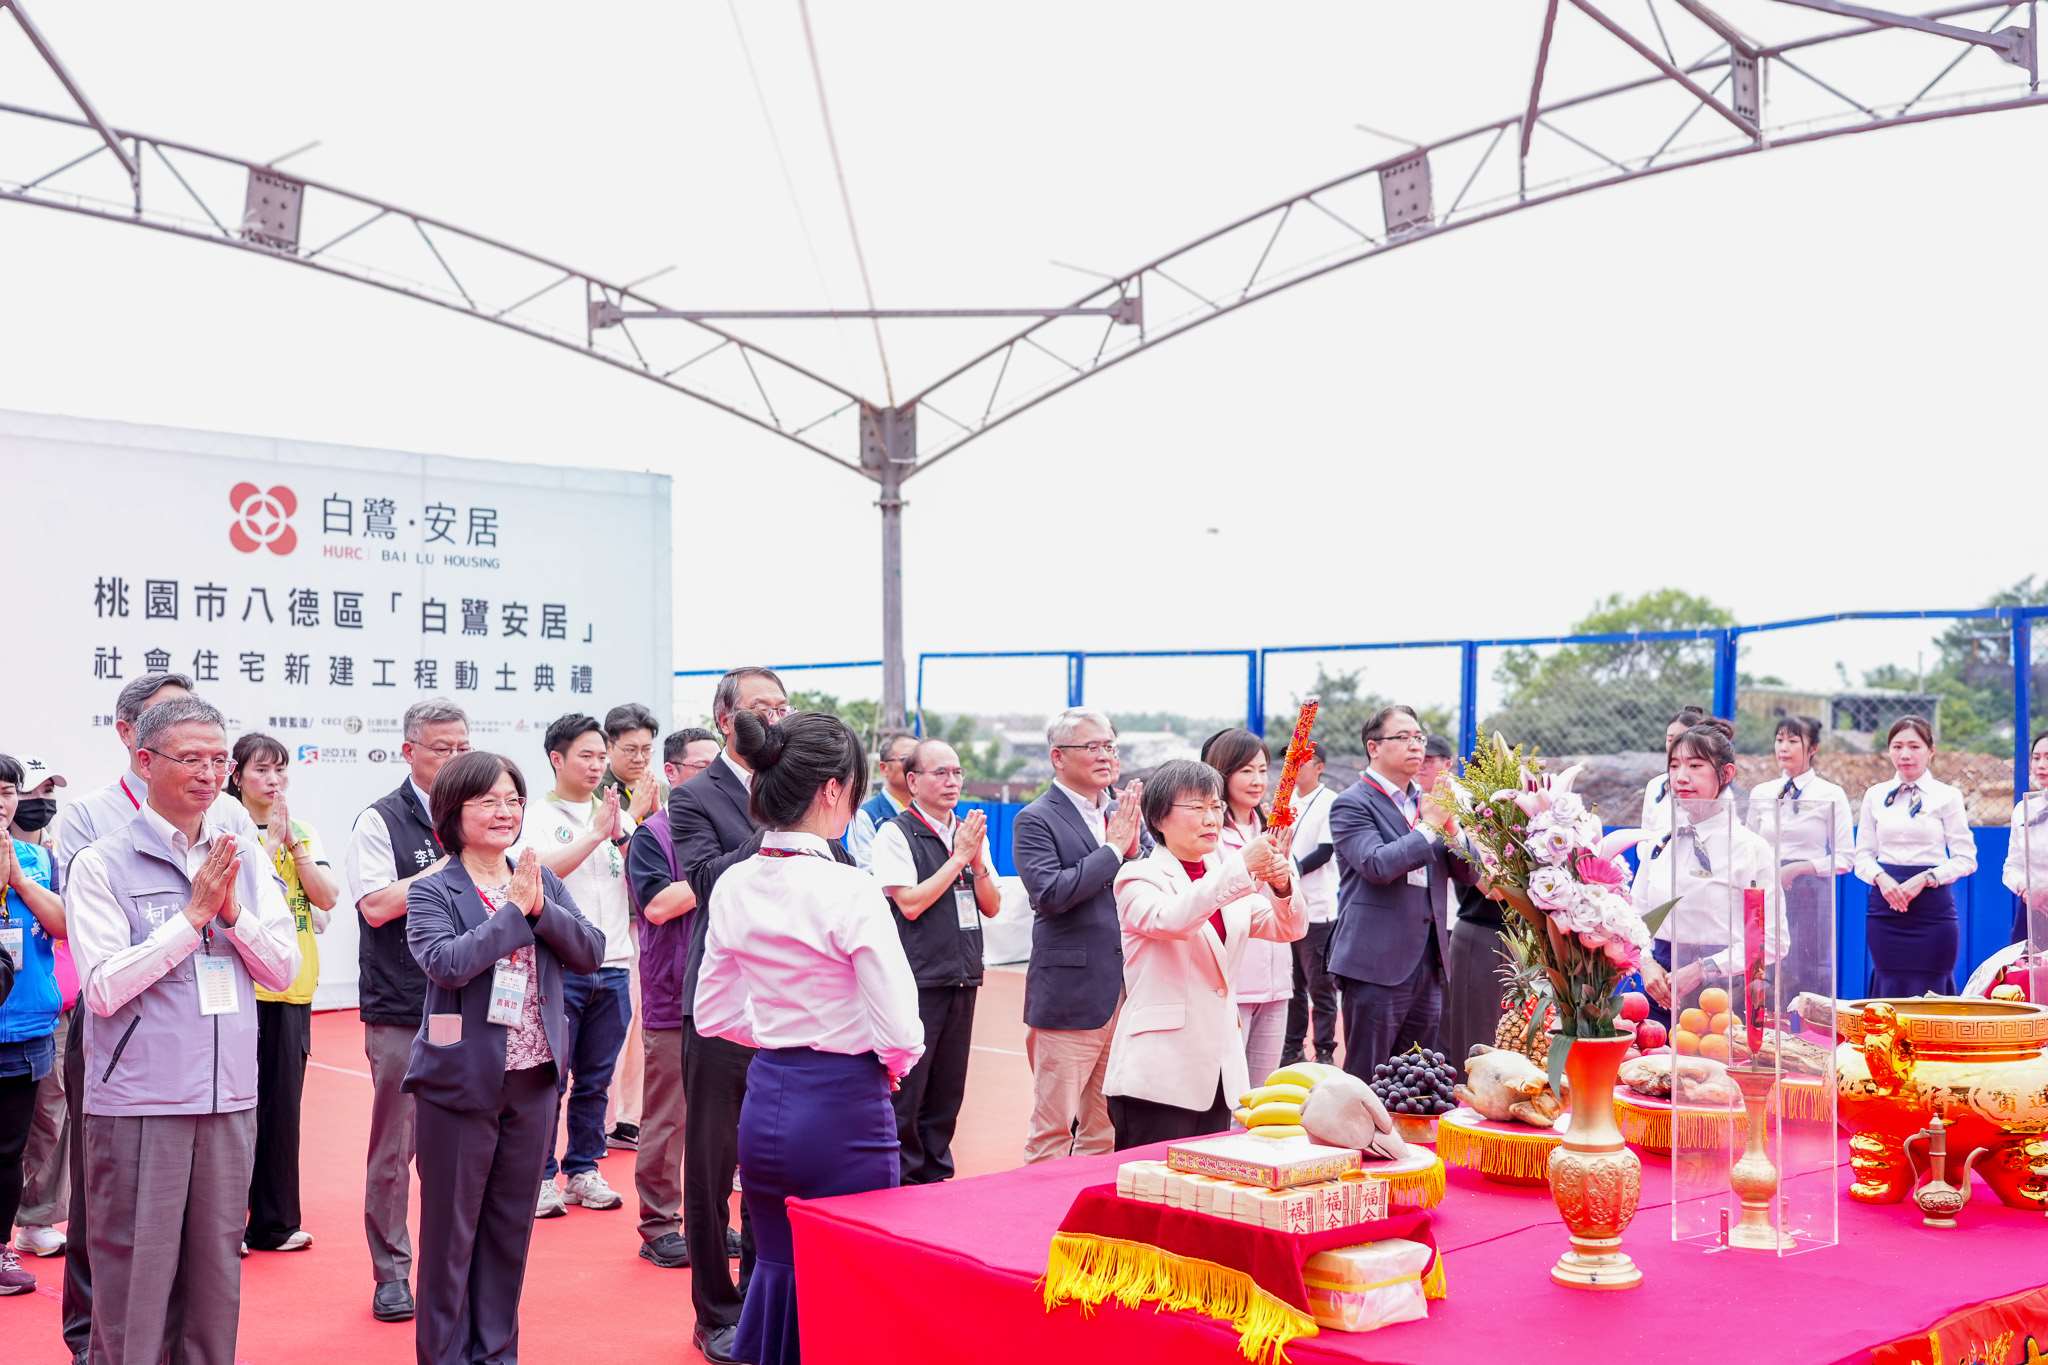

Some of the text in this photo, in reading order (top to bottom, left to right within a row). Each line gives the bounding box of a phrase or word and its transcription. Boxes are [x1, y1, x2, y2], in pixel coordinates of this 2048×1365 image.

[323, 545, 501, 570] HURC BAI LU HOUSING
[94, 576, 593, 643] 桃園市八德區「白鷺安居」
[94, 646, 593, 694] 社會住宅新建工程動土典禮
[414, 849, 429, 867] 李
[145, 901, 169, 925] 柯
